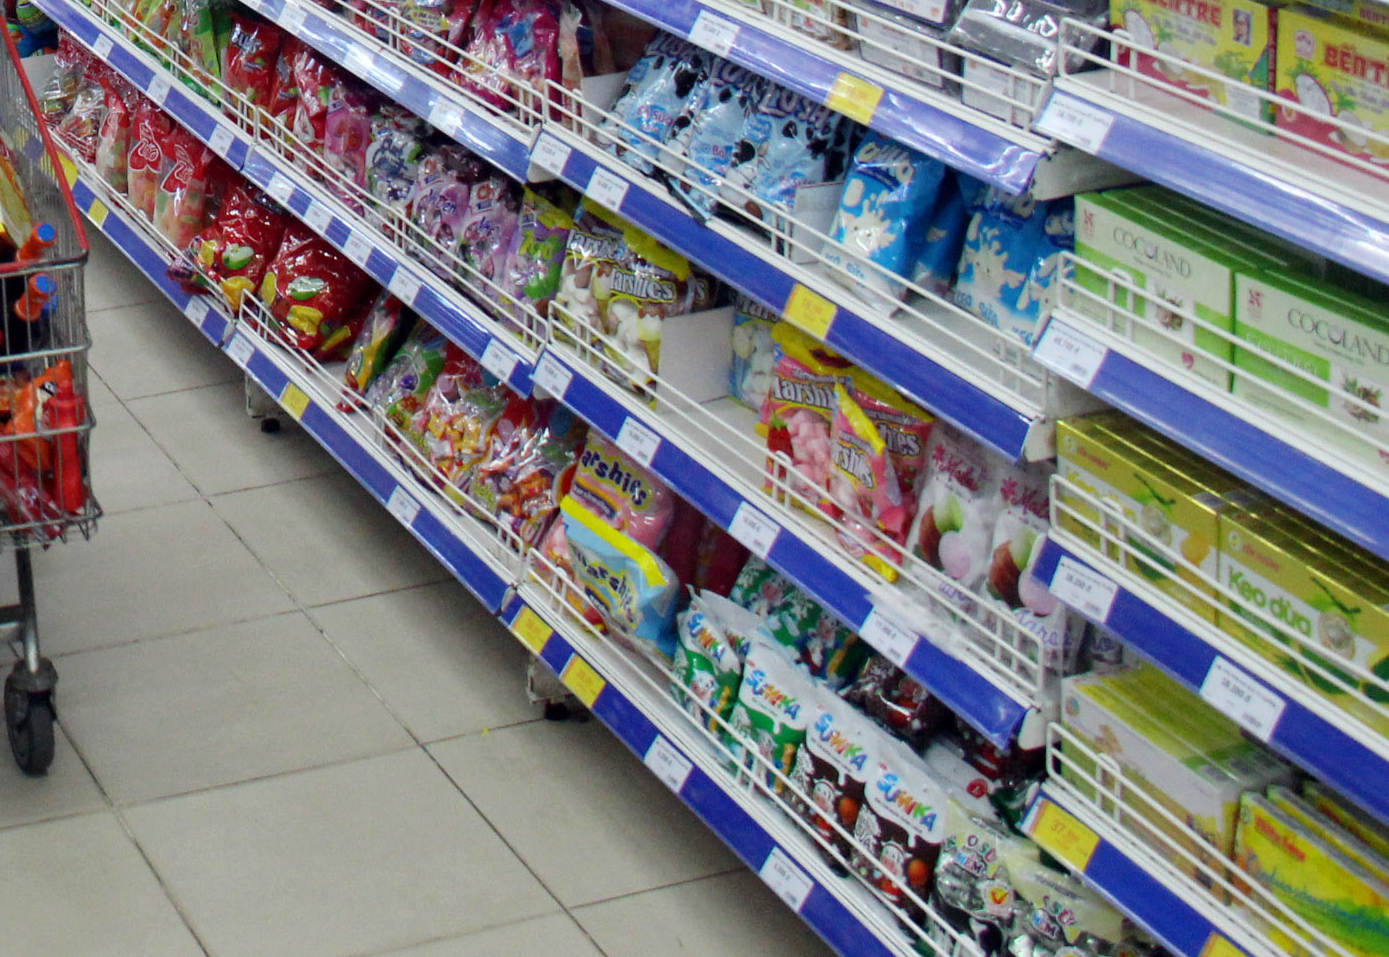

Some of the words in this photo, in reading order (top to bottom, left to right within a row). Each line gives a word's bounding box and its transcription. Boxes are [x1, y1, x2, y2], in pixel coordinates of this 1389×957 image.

[1112, 226, 1191, 278] COCOLAND
[746, 669, 801, 721] SUMIKA
[814, 712, 868, 771] SUMIKA
[876, 772, 938, 832] SUMIKA
